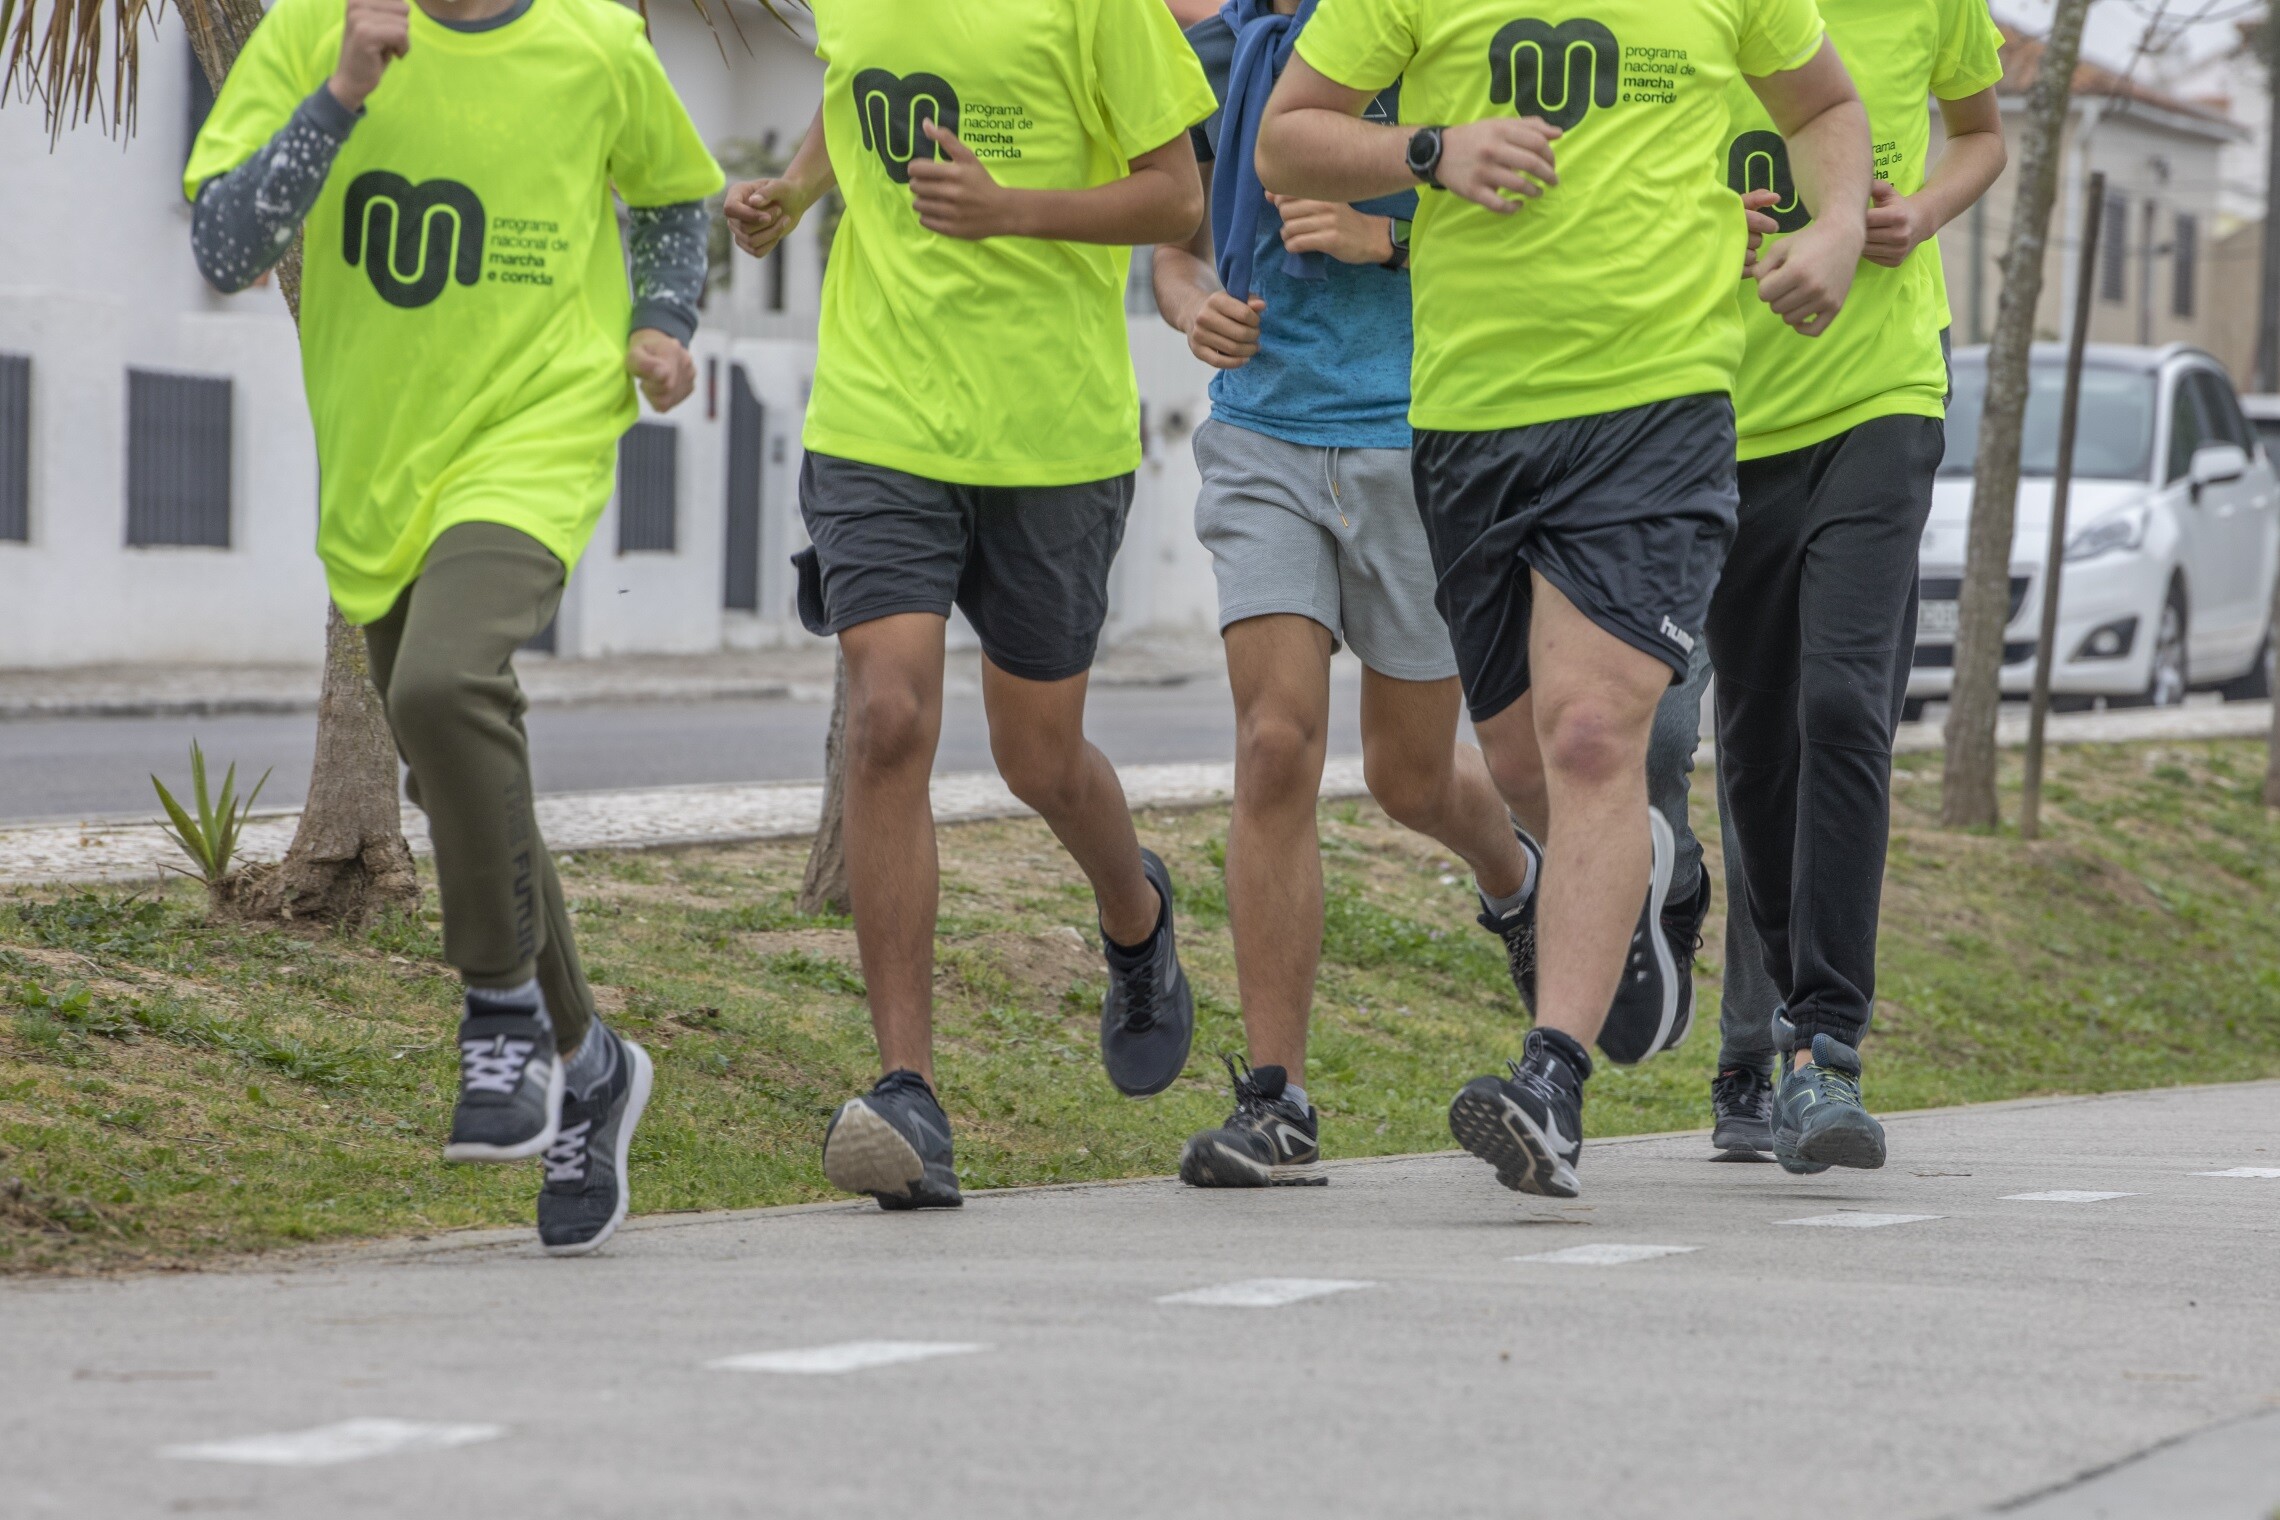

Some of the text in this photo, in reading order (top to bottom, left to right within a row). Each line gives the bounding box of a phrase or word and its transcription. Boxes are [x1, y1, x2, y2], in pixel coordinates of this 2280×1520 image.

[1625, 46, 1687, 60] programa
[1624, 61, 1696, 76] nacional de
[1623, 77, 1674, 89] marcha
[1622, 92, 1631, 102] e
[965, 103, 1023, 117] programa
[964, 117, 1033, 130] nacional de
[963, 132, 1014, 144] marcha
[975, 146, 1022, 158] corrida
[1891, 152, 1902, 163] de
[493, 217, 559, 234] programa
[490, 235, 569, 251] nacional de
[489, 253, 545, 267] marcha
[487, 271, 554, 286] e corrida
